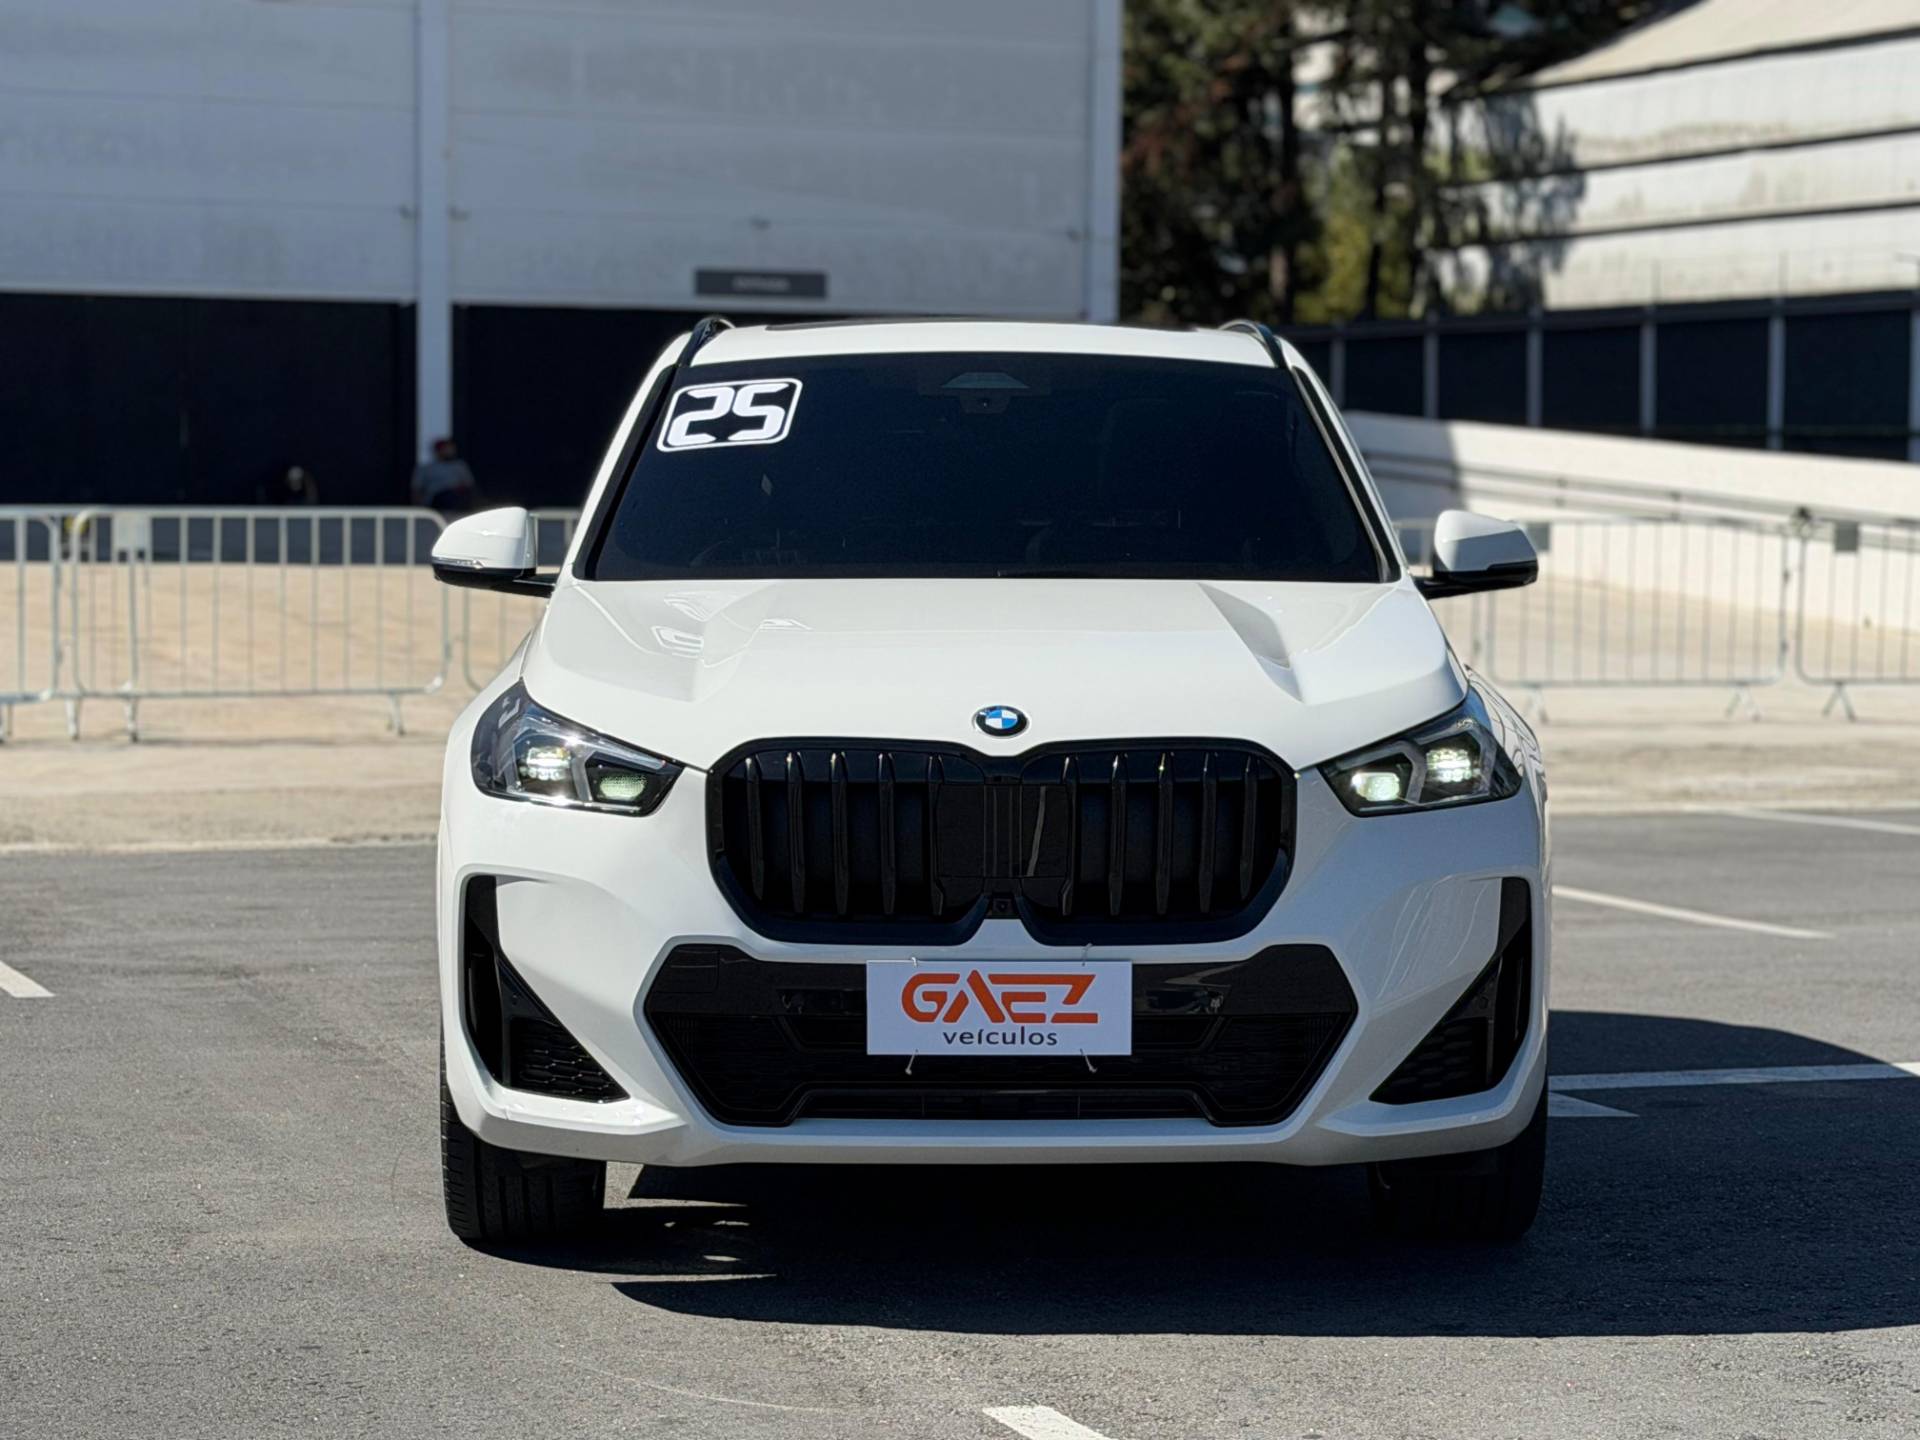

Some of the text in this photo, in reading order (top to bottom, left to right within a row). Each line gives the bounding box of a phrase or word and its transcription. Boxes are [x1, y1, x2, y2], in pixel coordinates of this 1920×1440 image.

[666, 383, 790, 447] 25
[901, 969, 1099, 1024] GAEZ
[943, 1026, 1058, 1046] veículos
